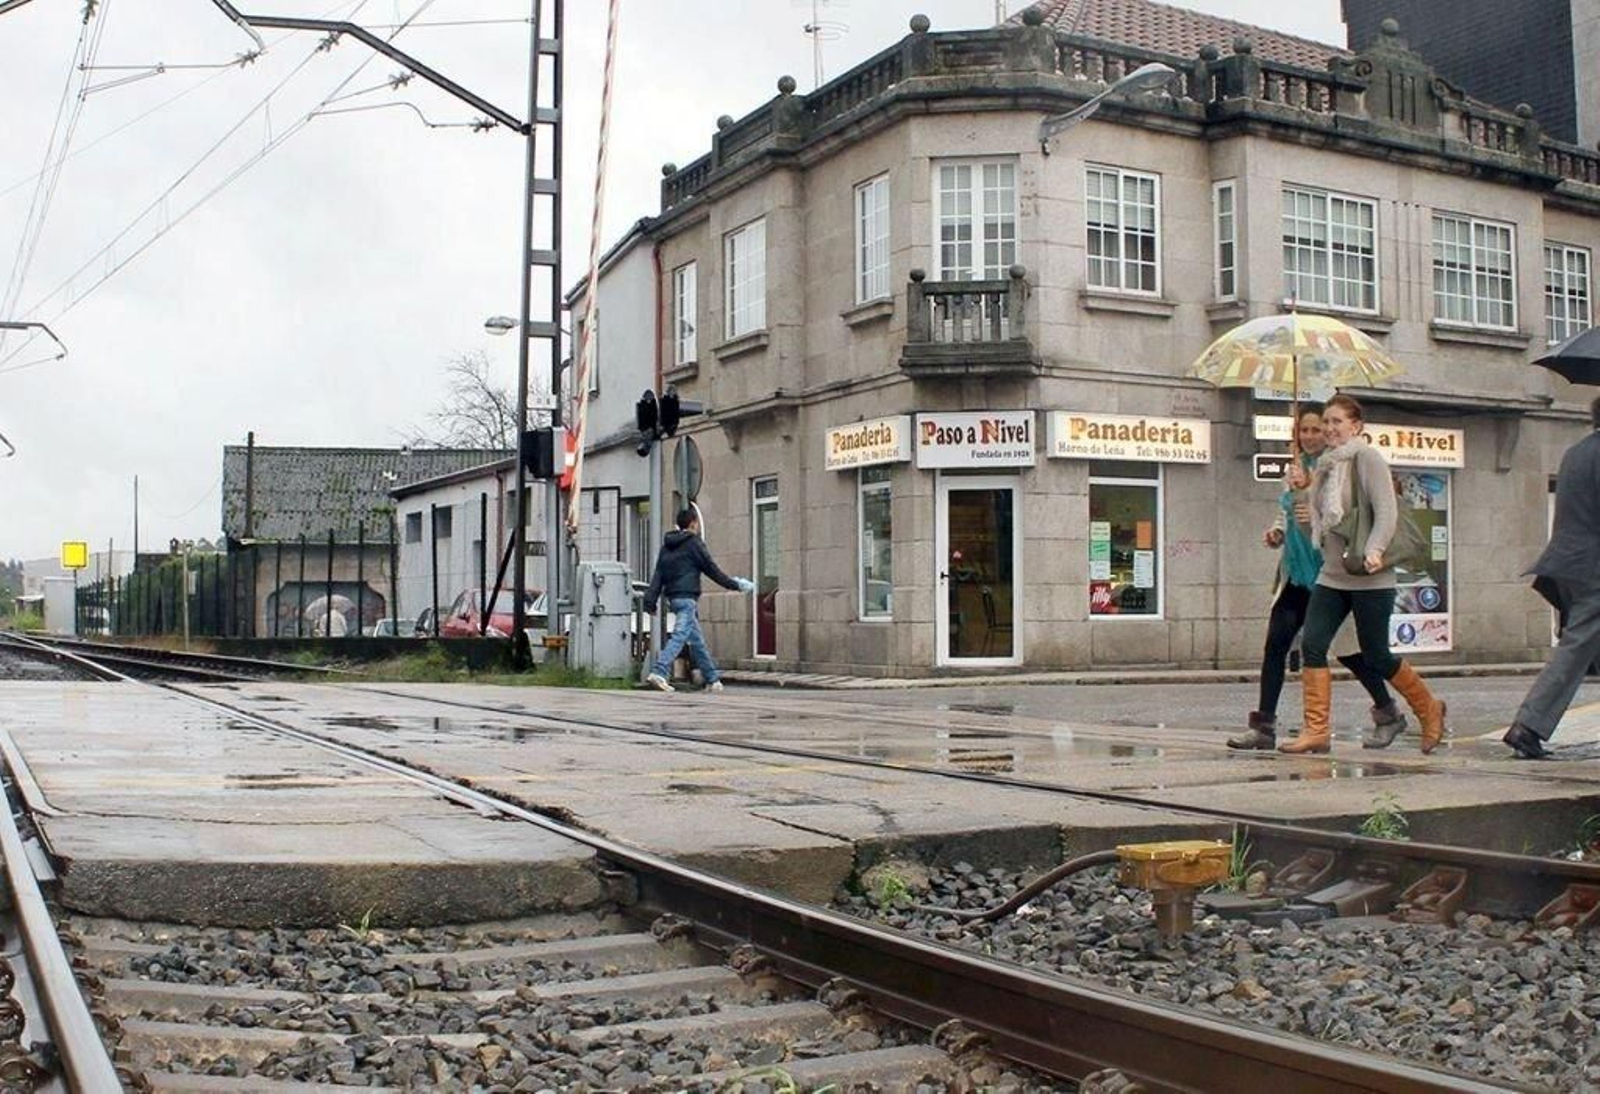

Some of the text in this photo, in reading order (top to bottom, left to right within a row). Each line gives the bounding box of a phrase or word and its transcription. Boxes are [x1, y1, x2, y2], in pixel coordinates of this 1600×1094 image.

[921, 419, 1029, 445] Paso a Nivel
[1379, 433, 1391, 447] a
[1396, 430, 1455, 451] Nivel
[1058, 441, 1087, 453] Horno
[1090, 444, 1100, 454] de
